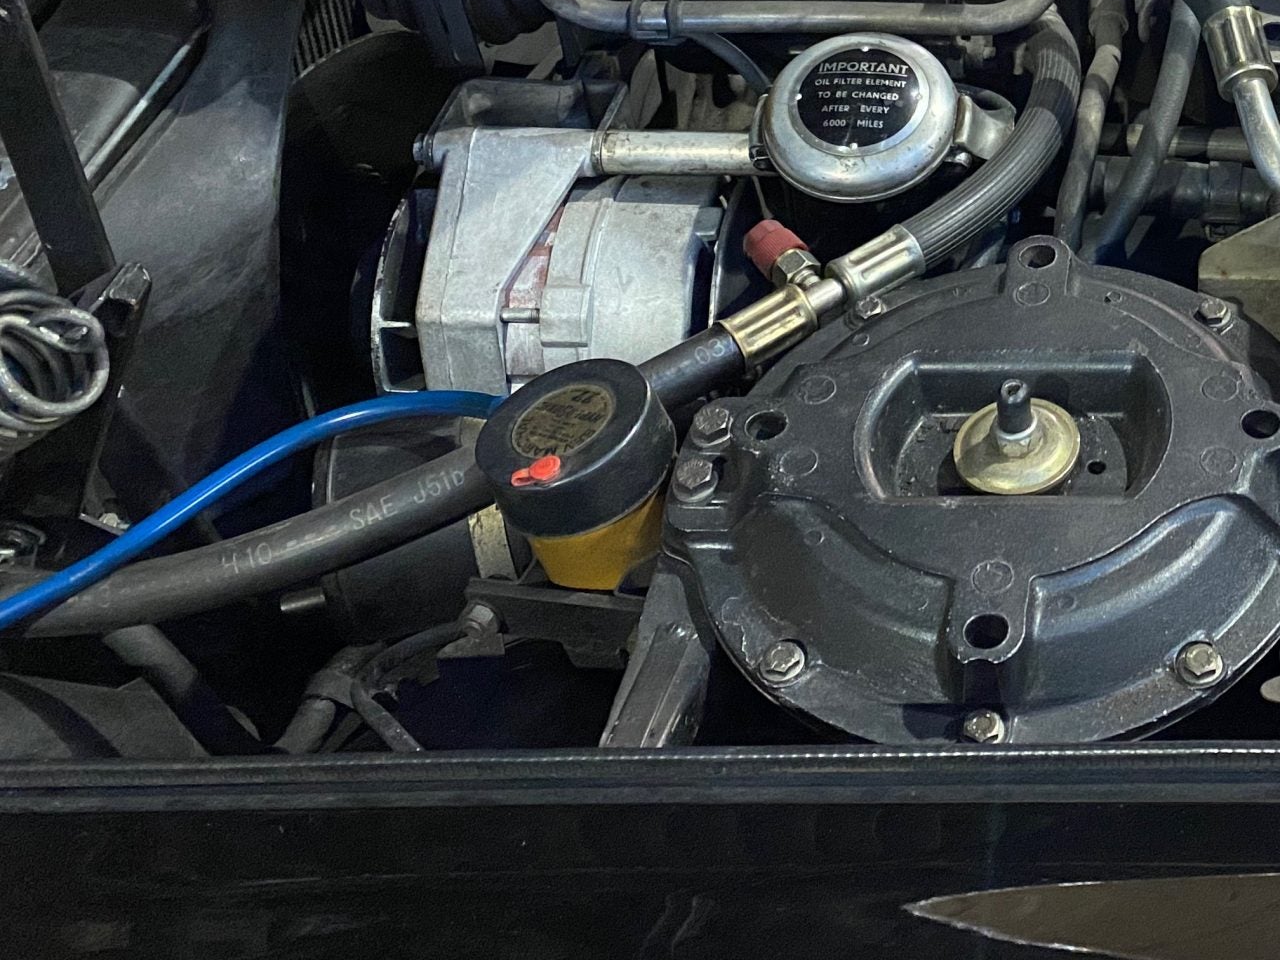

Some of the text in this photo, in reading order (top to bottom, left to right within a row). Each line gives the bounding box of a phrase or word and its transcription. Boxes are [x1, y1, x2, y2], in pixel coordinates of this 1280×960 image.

[818, 61, 909, 75] IMPORTANT
[814, 77, 907, 89] OIL FILTER ELEMENT
[851, 91, 900, 101] CHANGED
[859, 105, 891, 115] EVERY
[822, 119, 884, 129] 6000 MILES
[221, 542, 274, 576] 410
[348, 498, 404, 532] SAE
